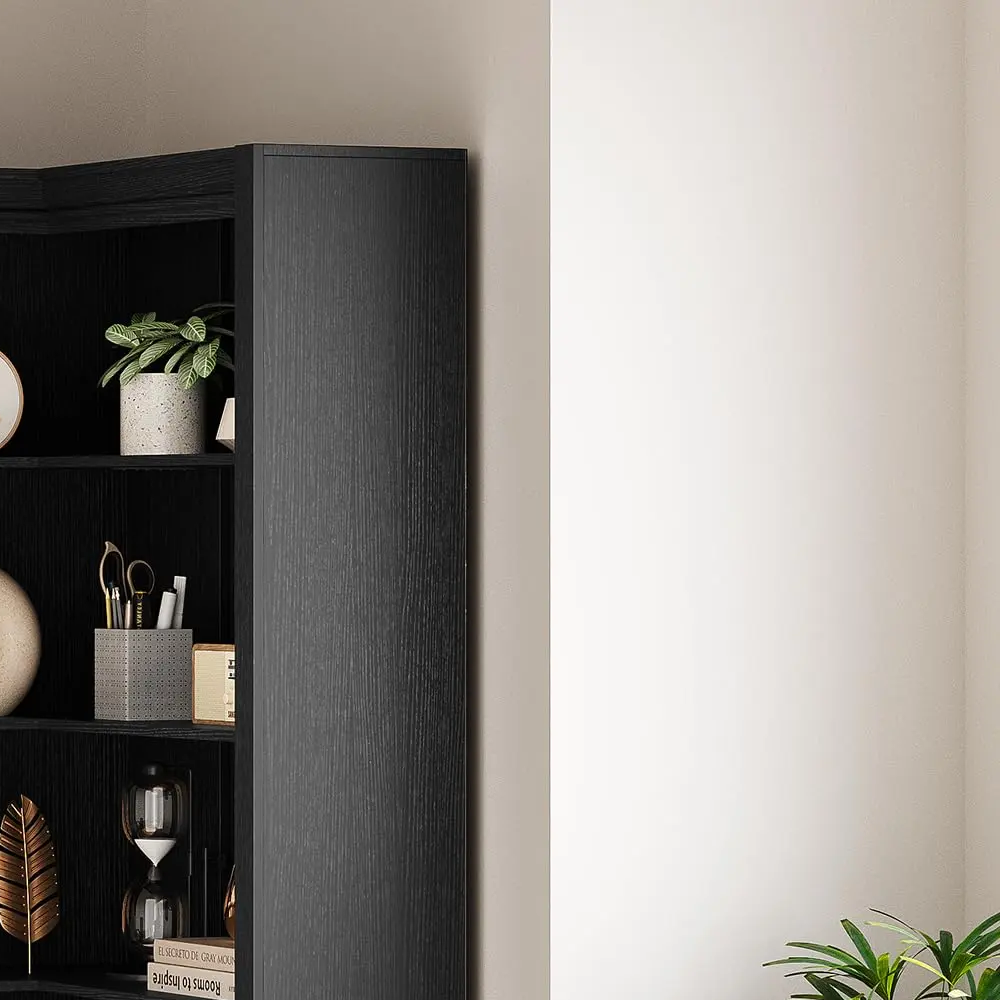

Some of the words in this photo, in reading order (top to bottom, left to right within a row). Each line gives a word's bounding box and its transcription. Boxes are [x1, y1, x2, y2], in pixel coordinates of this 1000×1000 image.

[159, 947, 165, 956] EL
[166, 948, 190, 959] SECRETO
[191, 951, 199, 960] DE
[201, 952, 217, 963] GRAY
[153, 970, 180, 991] Inspire
[183, 977, 191, 991] to
[193, 978, 221, 996] Rooms
